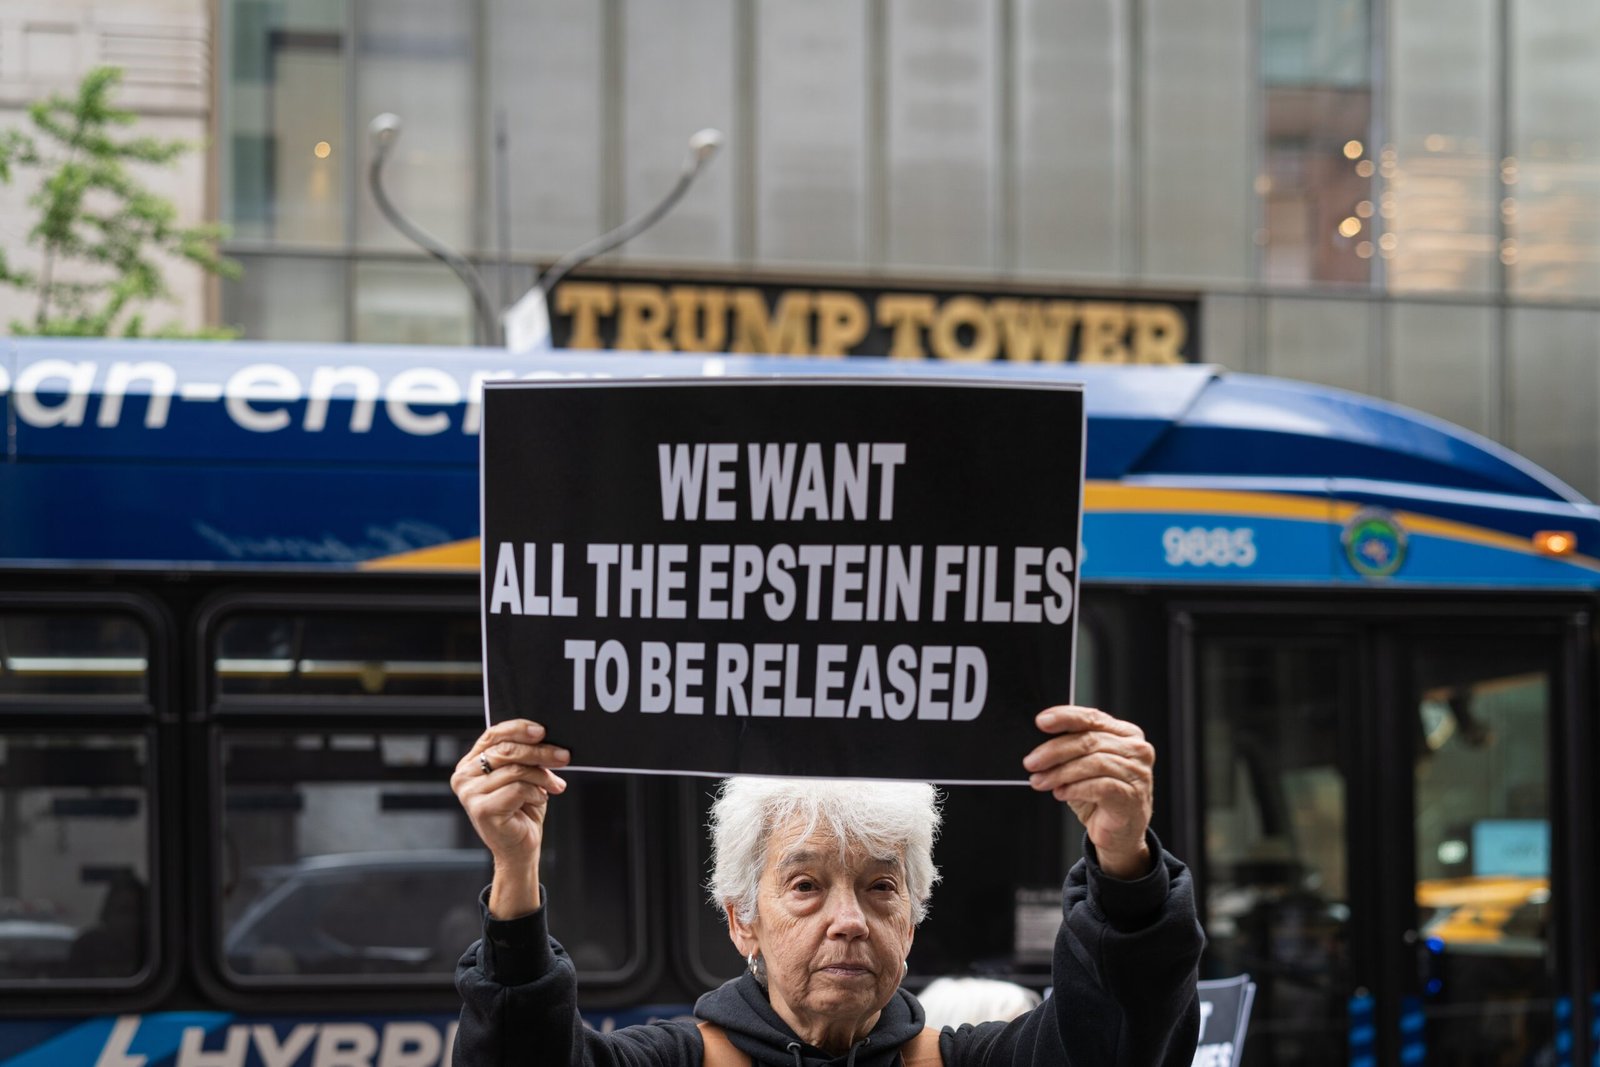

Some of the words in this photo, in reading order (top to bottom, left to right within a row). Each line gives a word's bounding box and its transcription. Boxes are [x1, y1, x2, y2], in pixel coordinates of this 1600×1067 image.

[555, 281, 870, 357] TRUMP
[876, 294, 1187, 364] TOWER
[658, 443, 739, 521] WE
[747, 442, 906, 521] WANT
[489, 541, 579, 617] ALL
[586, 543, 689, 620] THE
[697, 543, 923, 622] EPSTEIN
[932, 545, 1074, 625] FILES
[1162, 526, 1257, 567] 9885
[564, 639, 630, 713] TO
[639, 641, 706, 715] BE
[715, 642, 989, 721] RELEASED
